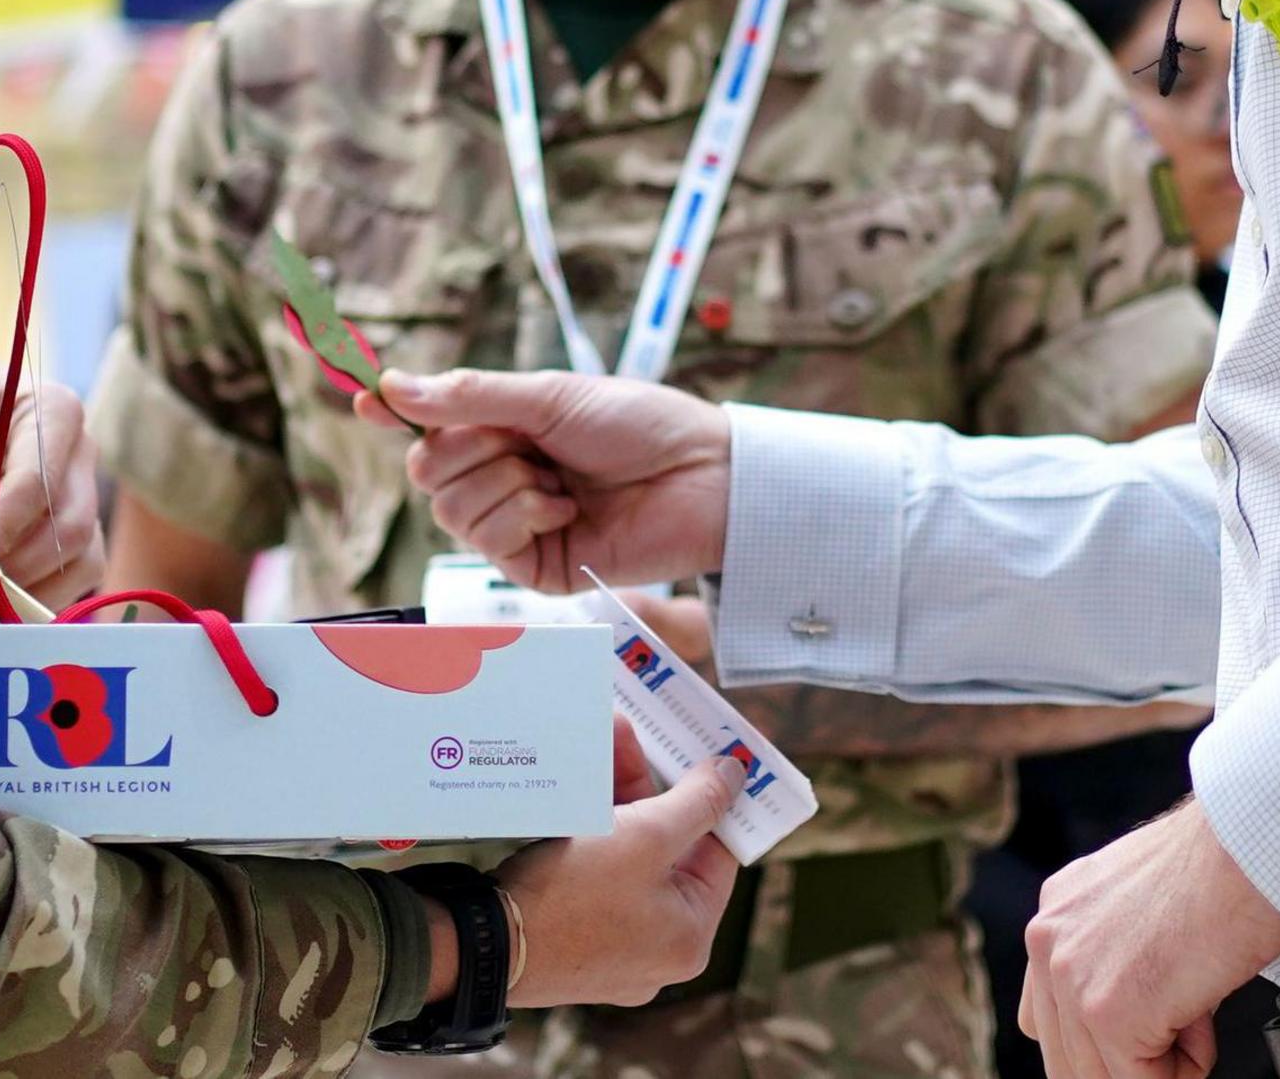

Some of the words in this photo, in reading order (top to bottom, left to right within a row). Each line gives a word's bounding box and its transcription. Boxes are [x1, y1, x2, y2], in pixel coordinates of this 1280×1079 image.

[437, 747, 458, 759] FR
[469, 746, 537, 756] FUNDRAISING
[469, 756, 537, 765] REGULATOR
[33, 781, 101, 793] BRITISH
[107, 781, 171, 793] LEGION
[430, 780, 475, 790] Registered
[478, 780, 505, 790] charity
